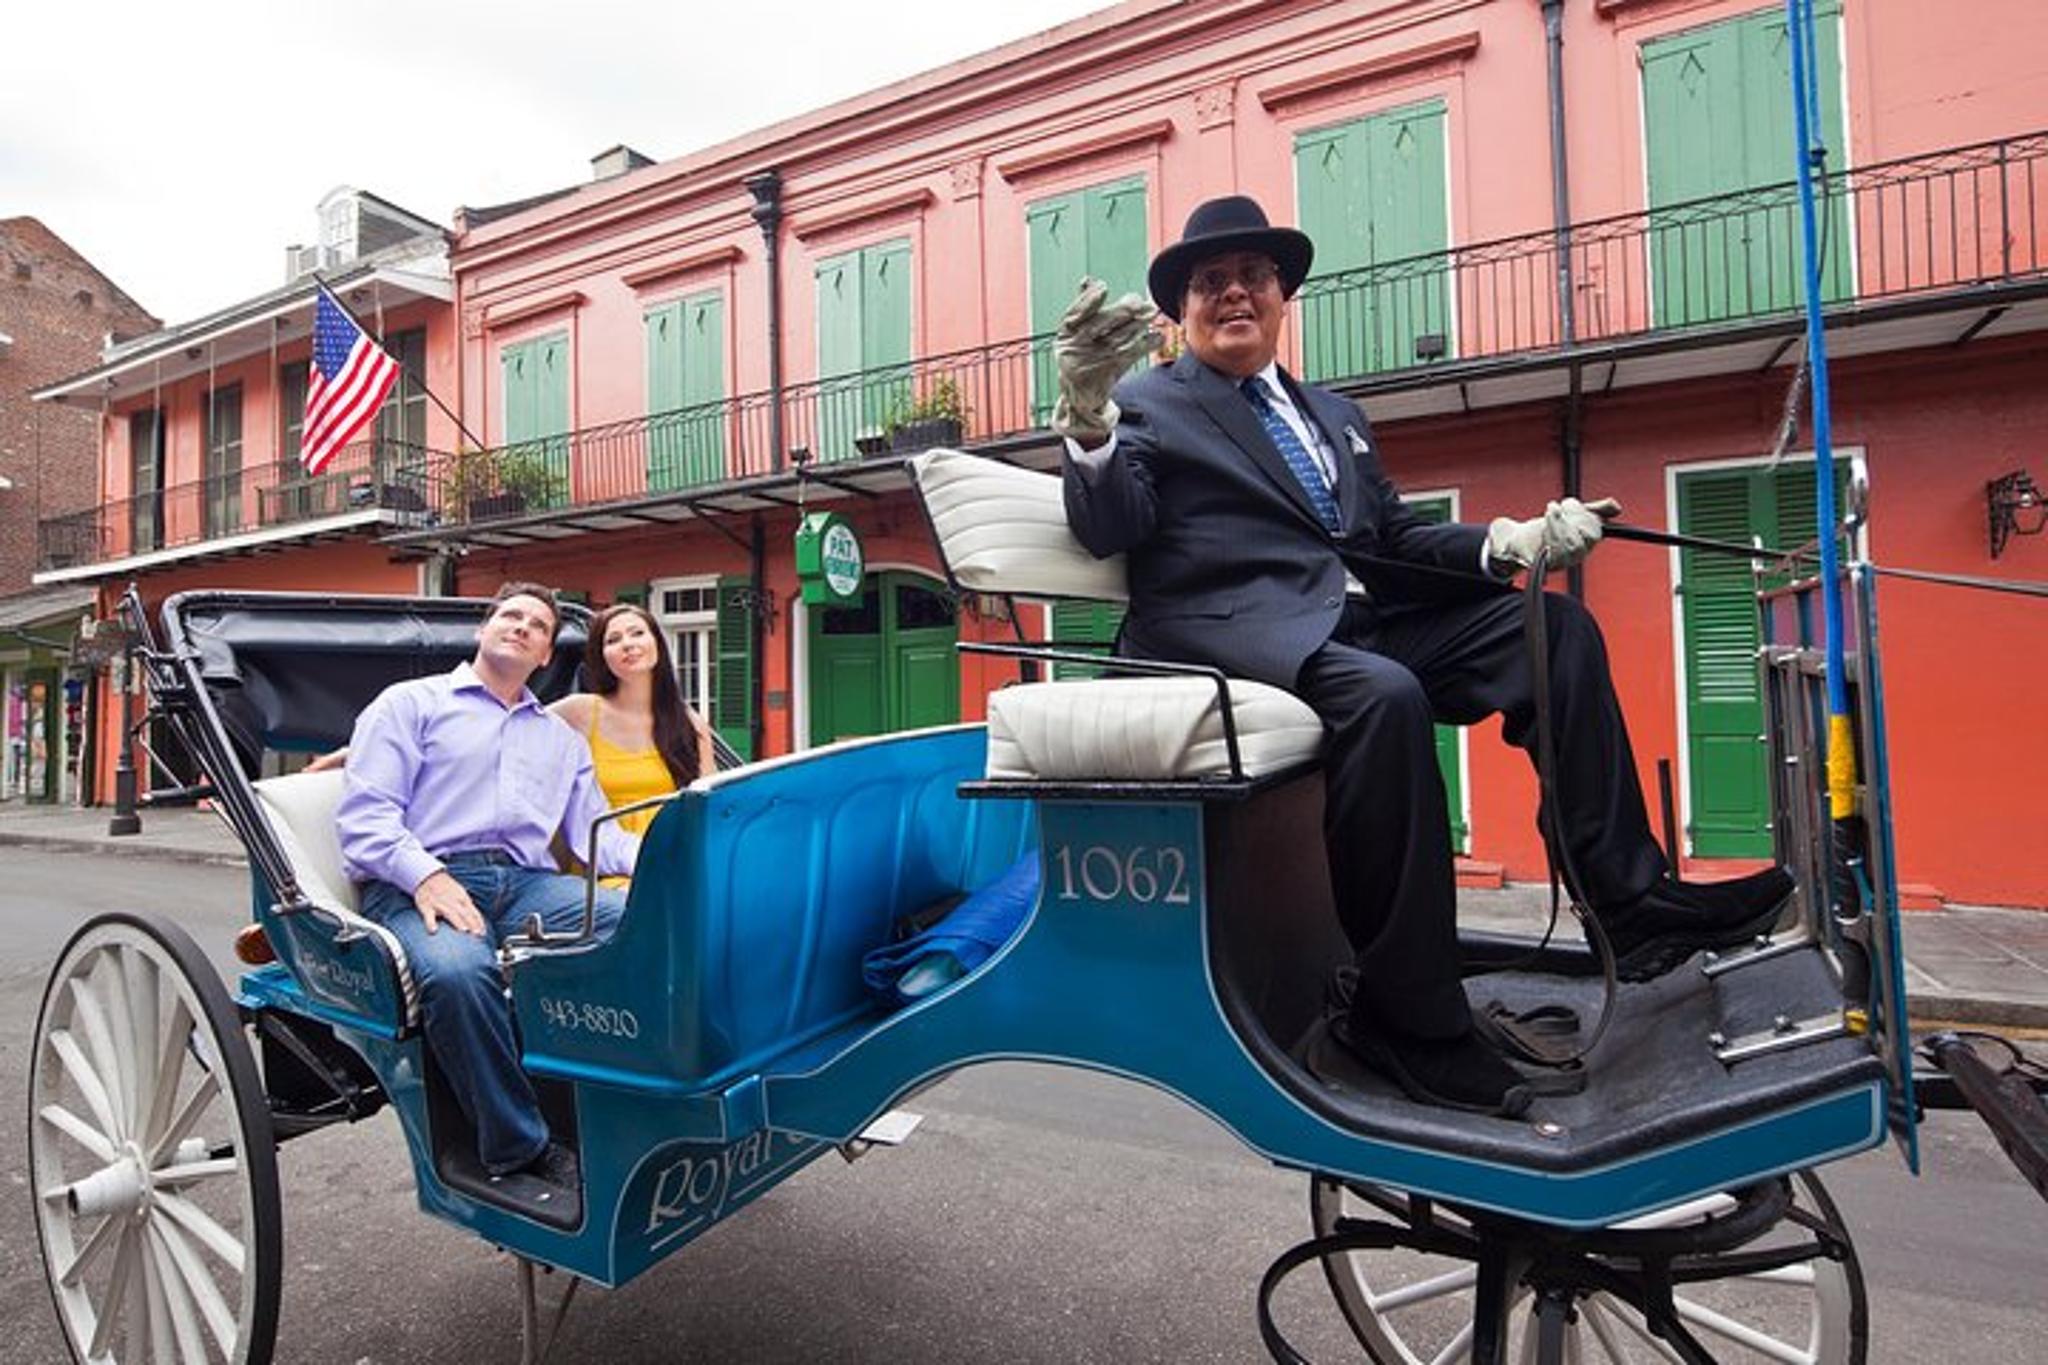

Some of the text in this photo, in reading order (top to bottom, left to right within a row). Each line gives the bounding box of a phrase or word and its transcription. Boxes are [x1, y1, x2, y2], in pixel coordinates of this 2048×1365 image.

[1056, 845, 1190, 903] 1062
[540, 998, 638, 1038] 943-8820
[645, 1129, 773, 1235] Royal
